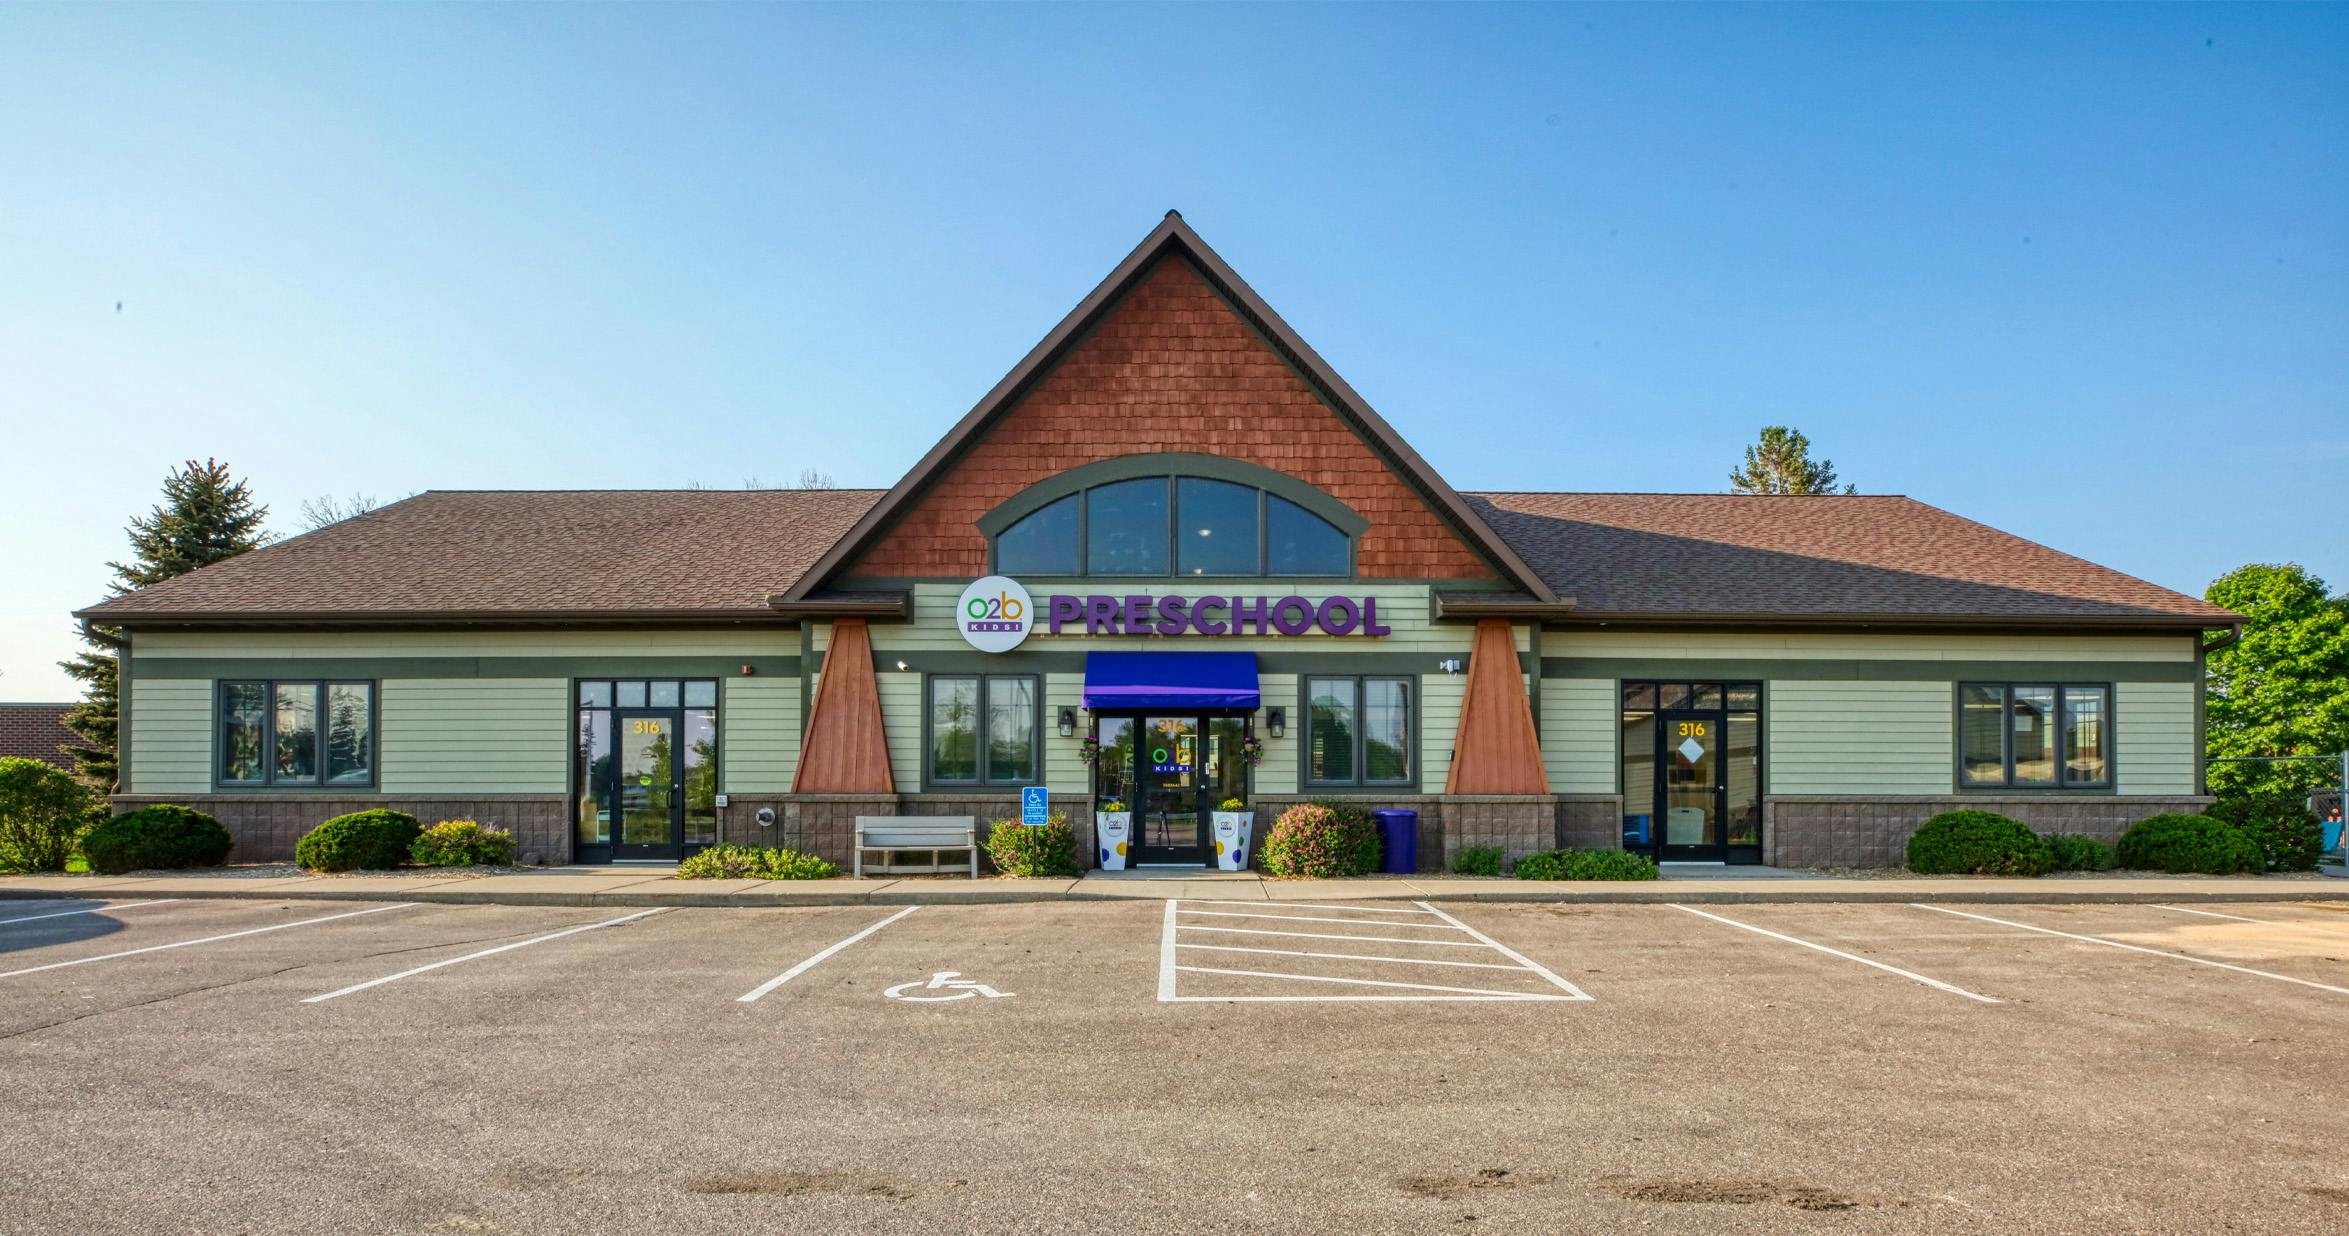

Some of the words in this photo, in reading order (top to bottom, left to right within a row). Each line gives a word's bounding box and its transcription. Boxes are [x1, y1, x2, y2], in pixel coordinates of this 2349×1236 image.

[968, 591, 1023, 620] o2b
[1049, 595, 1391, 636] PRESCHOOL
[633, 720, 661, 735] 316
[1158, 719, 1185, 733] 316
[1679, 723, 1705, 736] 316
